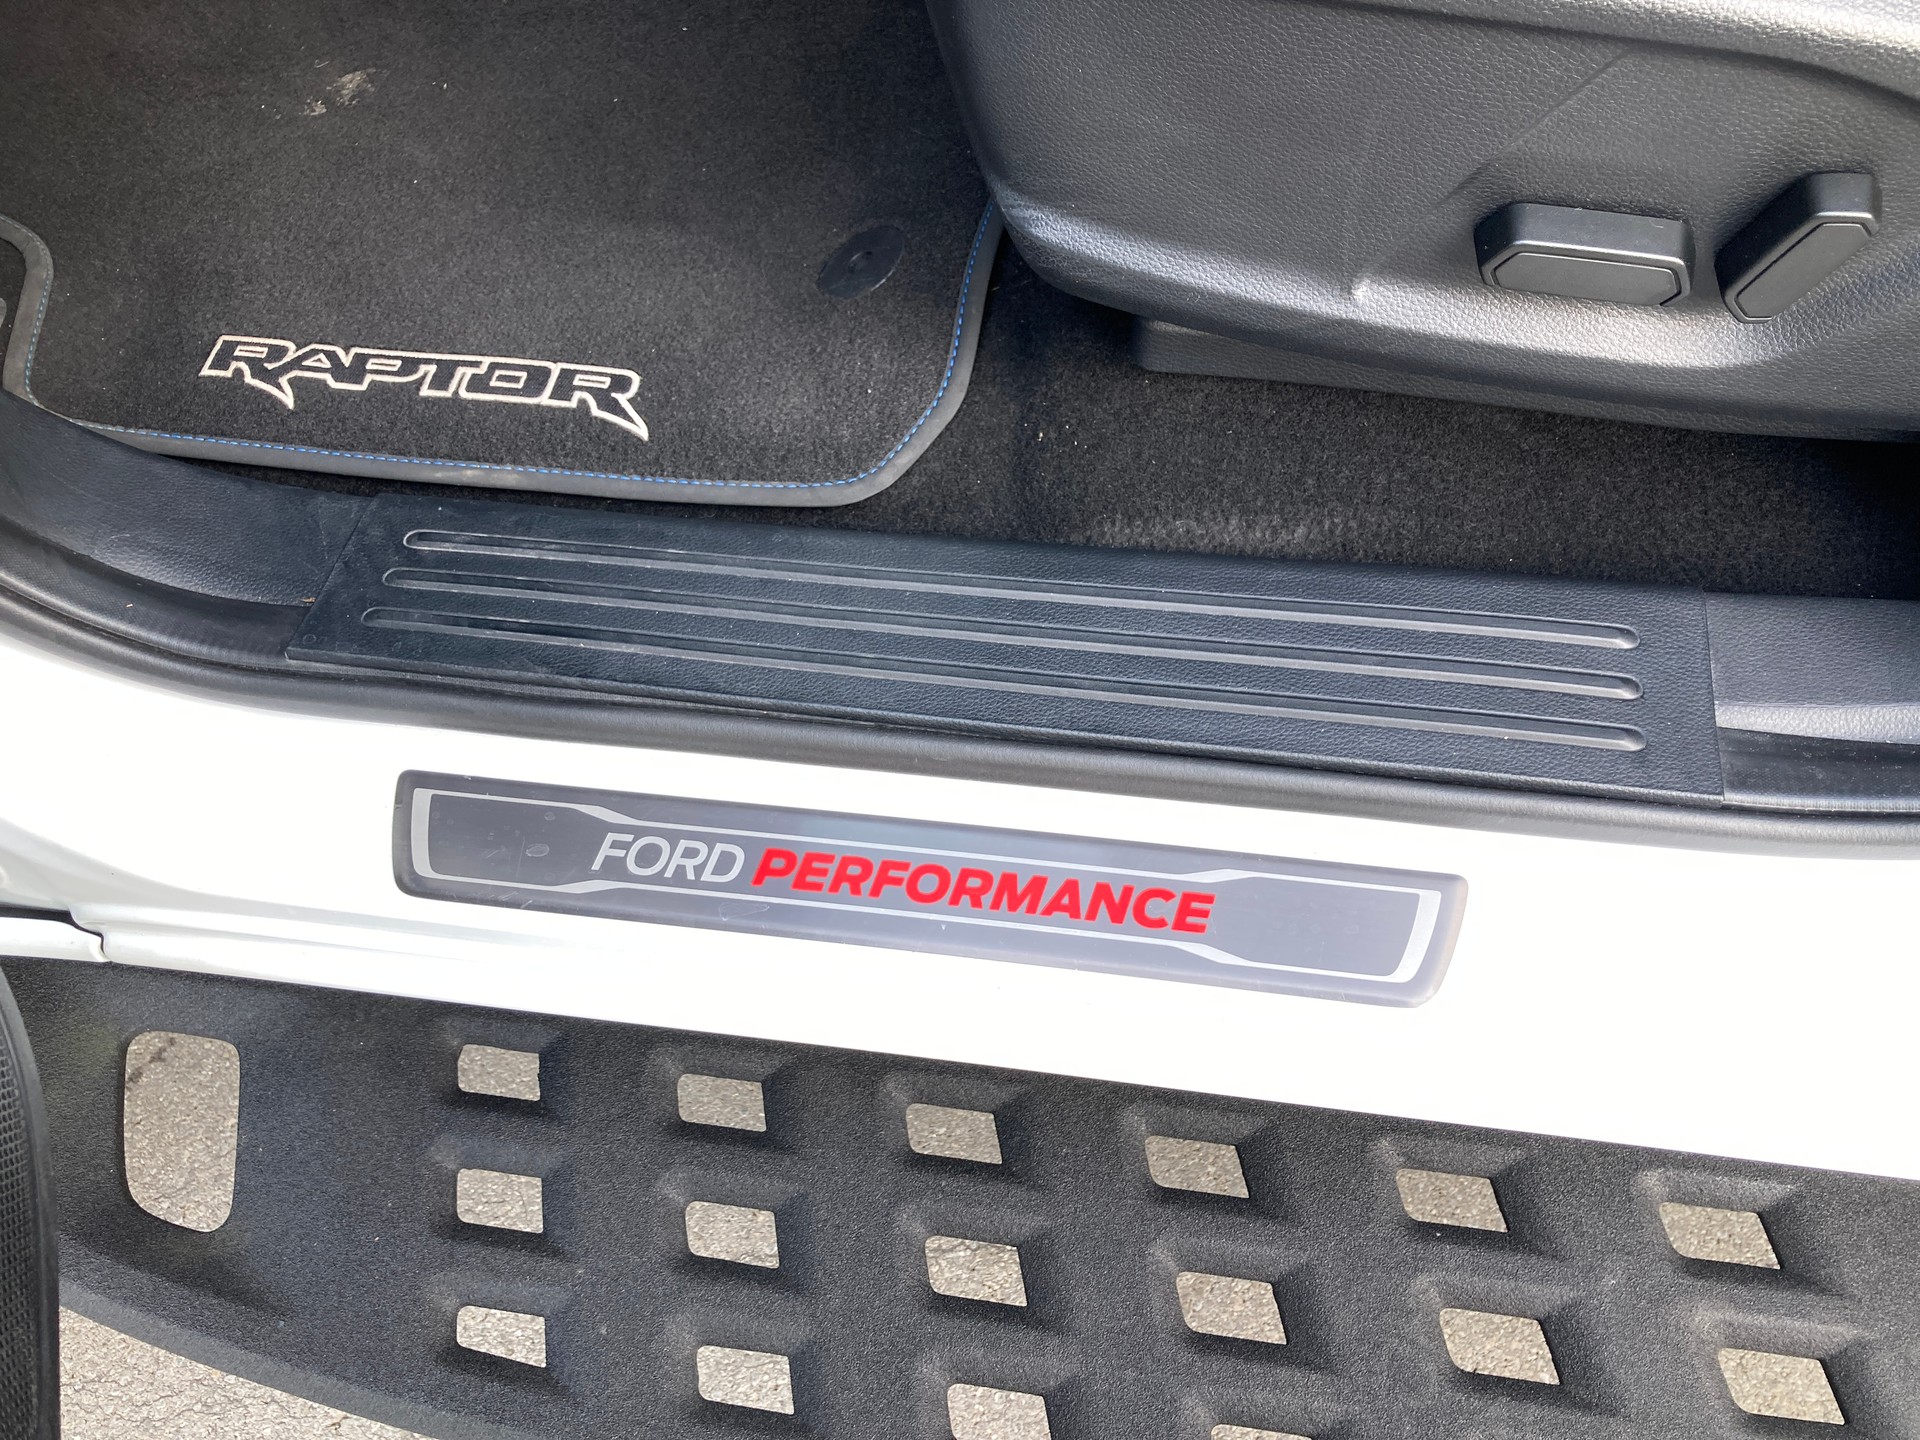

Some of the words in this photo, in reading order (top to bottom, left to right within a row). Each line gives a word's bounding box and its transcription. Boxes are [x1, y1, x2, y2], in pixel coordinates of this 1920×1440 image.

[199, 334, 649, 441] RAPTOR
[591, 832, 745, 884] FORD
[751, 848, 1216, 934] PERFORMANCE
